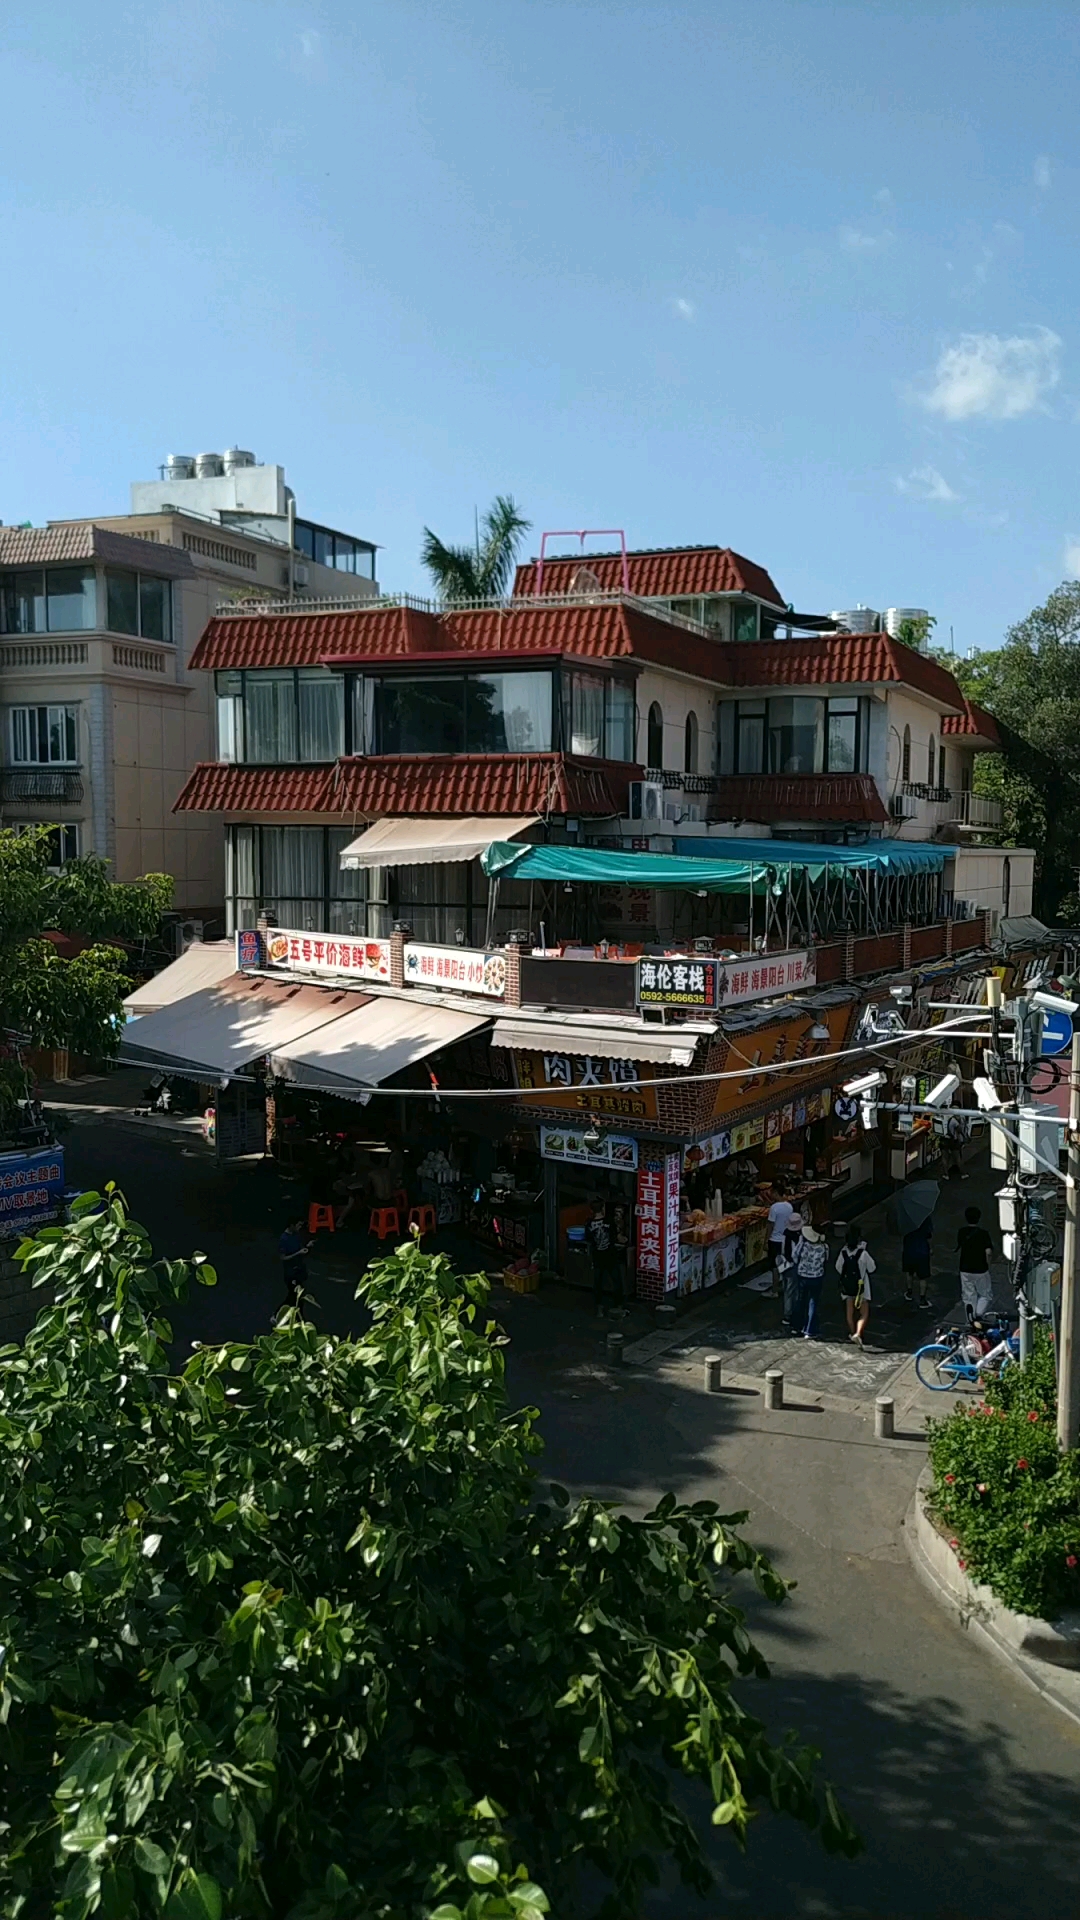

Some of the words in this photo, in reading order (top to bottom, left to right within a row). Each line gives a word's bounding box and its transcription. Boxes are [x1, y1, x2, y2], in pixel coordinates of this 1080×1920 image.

[289, 939, 365, 969] 五号平价海鲜
[640, 963, 705, 992] 海伦客栈
[704, 964, 715, 1006] 今日有房
[731, 970, 749, 996] 海鲜
[751, 963, 784, 992] 海景阳台
[640, 991, 705, 1005] 0592-5666635
[543, 1055, 641, 1093] 肉夹馍
[639, 1171, 661, 1272] 土耳其肉夹馍
